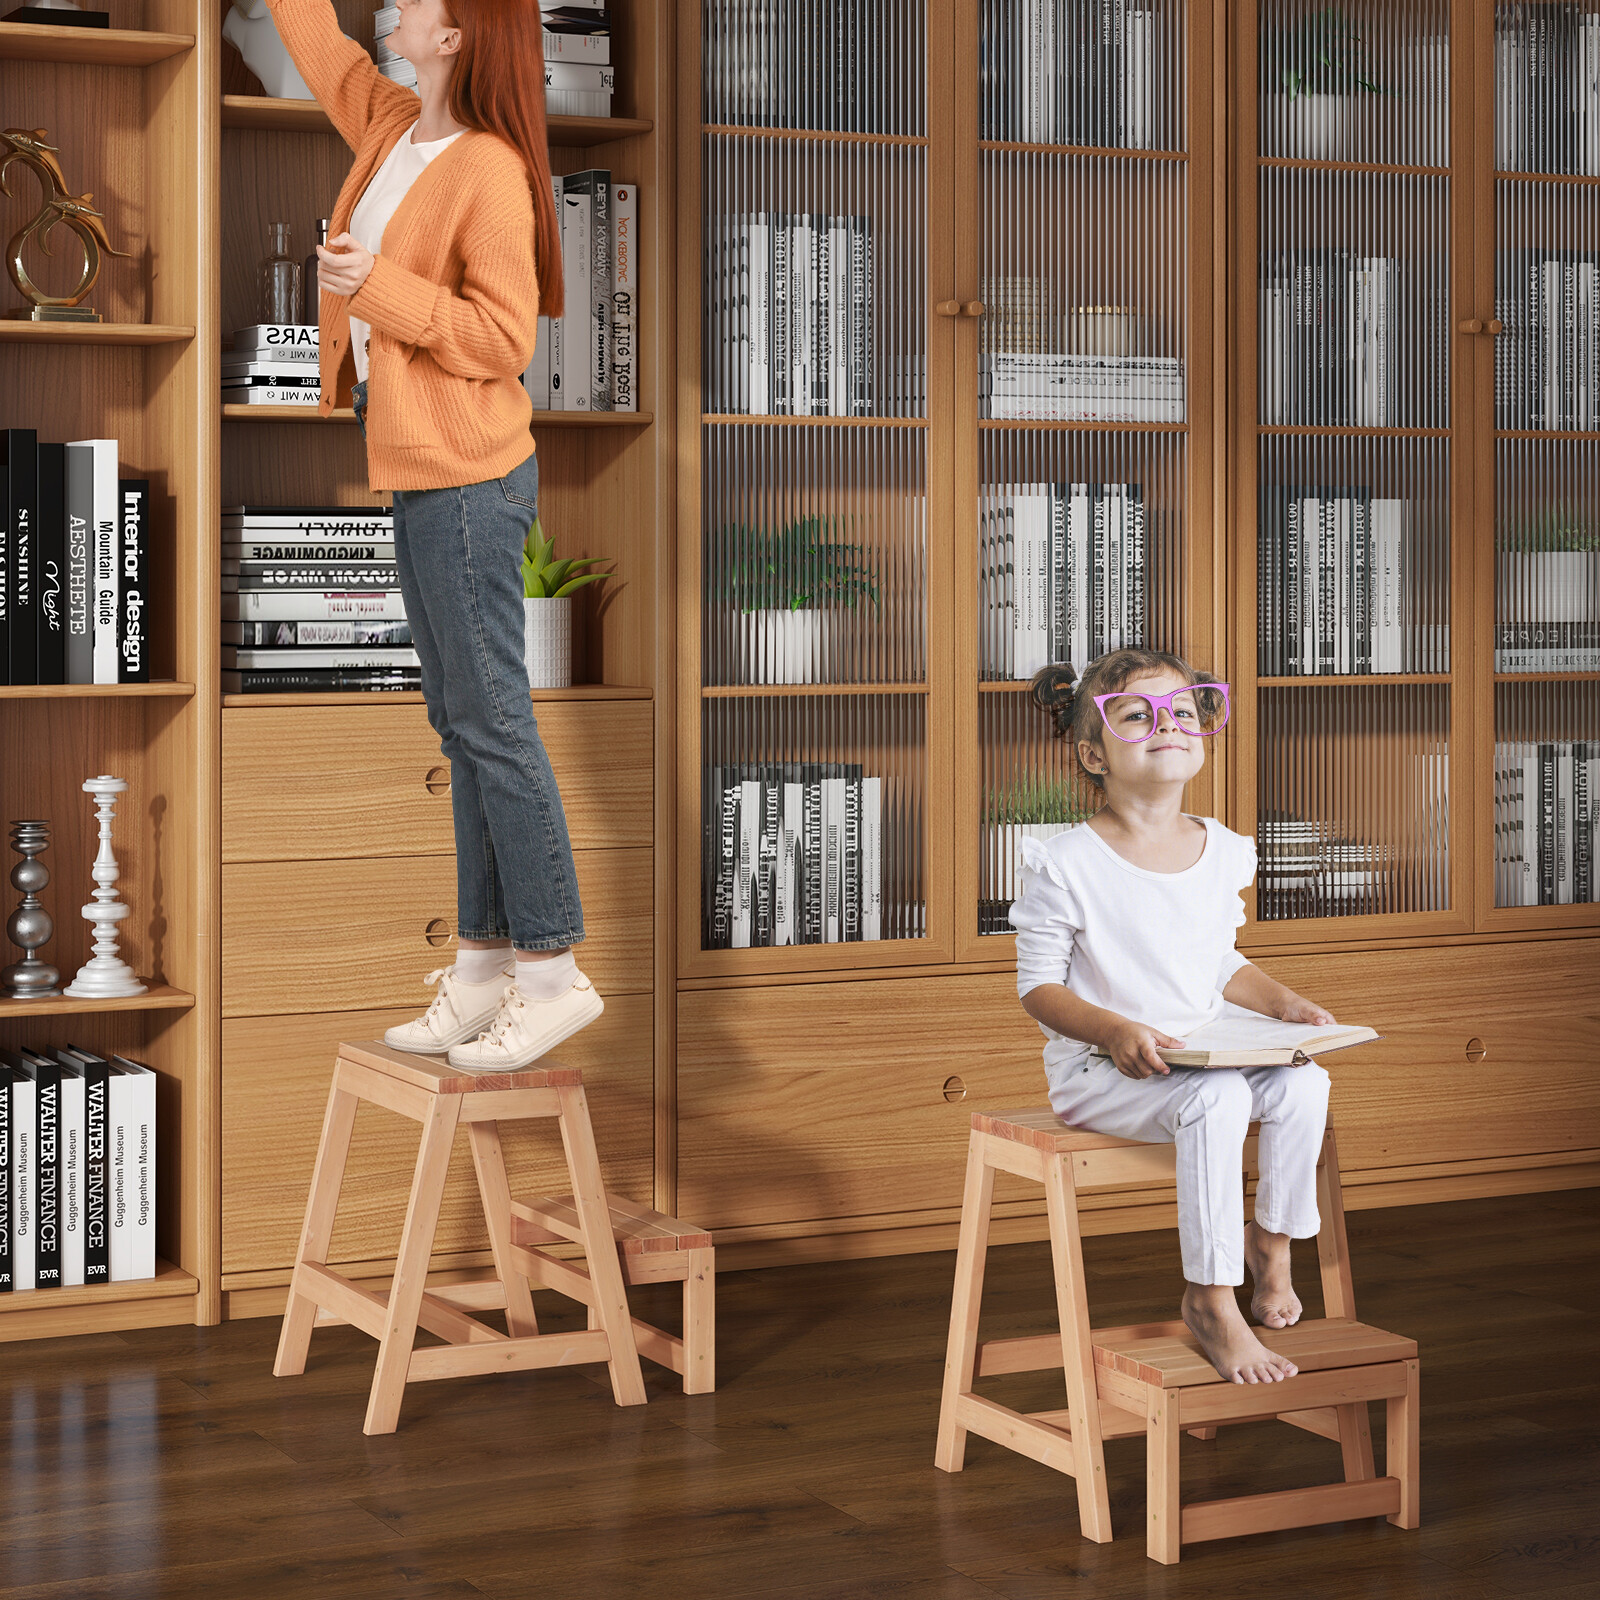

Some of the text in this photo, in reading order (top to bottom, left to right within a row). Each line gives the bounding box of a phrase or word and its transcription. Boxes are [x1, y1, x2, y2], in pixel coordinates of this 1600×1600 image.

[18, 508, 29, 606] SUNSHINE
[43, 560, 60, 631] Night
[70, 514, 87, 635] AESTHETE
[99, 521, 114, 625] Mountain Guide
[123, 491, 144, 673] Interior design
[18, 1132, 29, 1236] Guggenheim Museum
[40, 1083, 56, 1252] WALTER FINANCE
[67, 1129, 78, 1232] Guggenheim Museum
[88, 1080, 104, 1248] WALTER FINANCE
[114, 1125, 125, 1228] Guggenheim Museum
[138, 1124, 149, 1226] Guggenheim Museum
[39, 1269, 59, 1279] EVR
[87, 1265, 107, 1275] EVR
